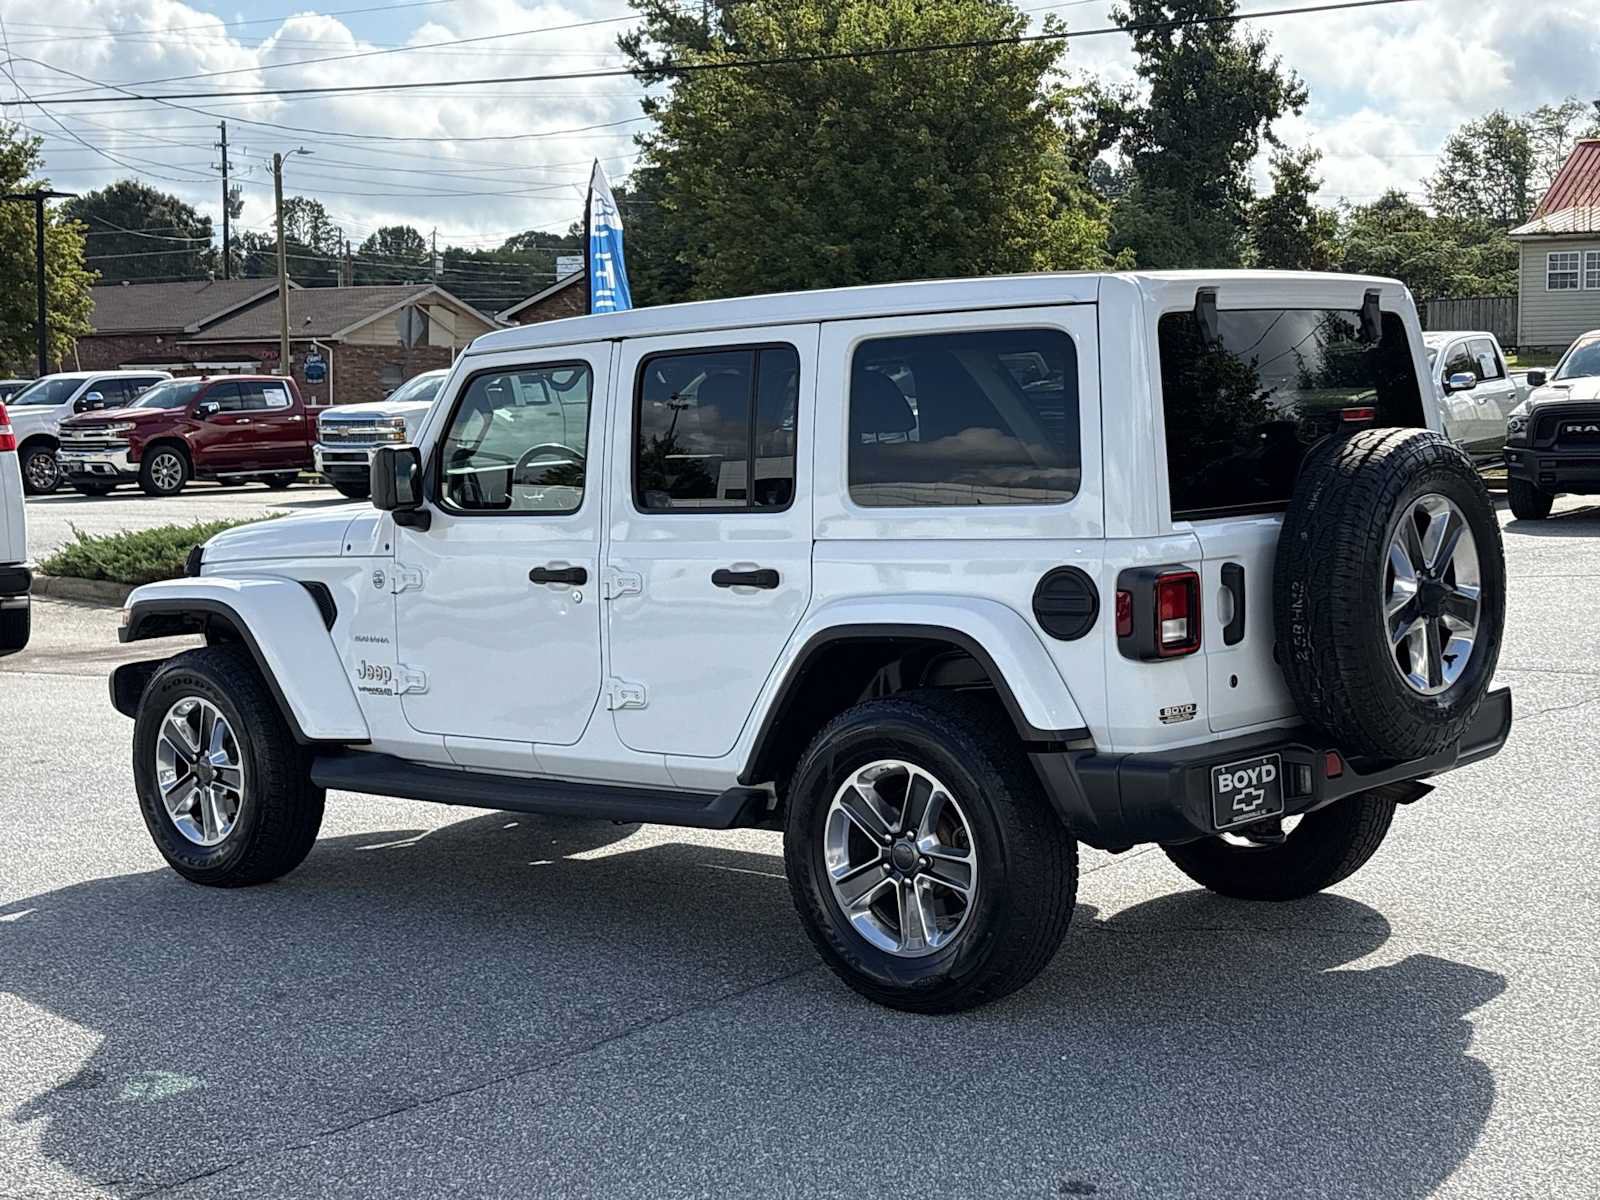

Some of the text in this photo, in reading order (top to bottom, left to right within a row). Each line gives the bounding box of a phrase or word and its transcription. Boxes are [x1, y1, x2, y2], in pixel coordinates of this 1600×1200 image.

[355, 659, 392, 685] Jeep
[1164, 704, 1193, 716] BOYD
[1217, 764, 1277, 794] BOYD
